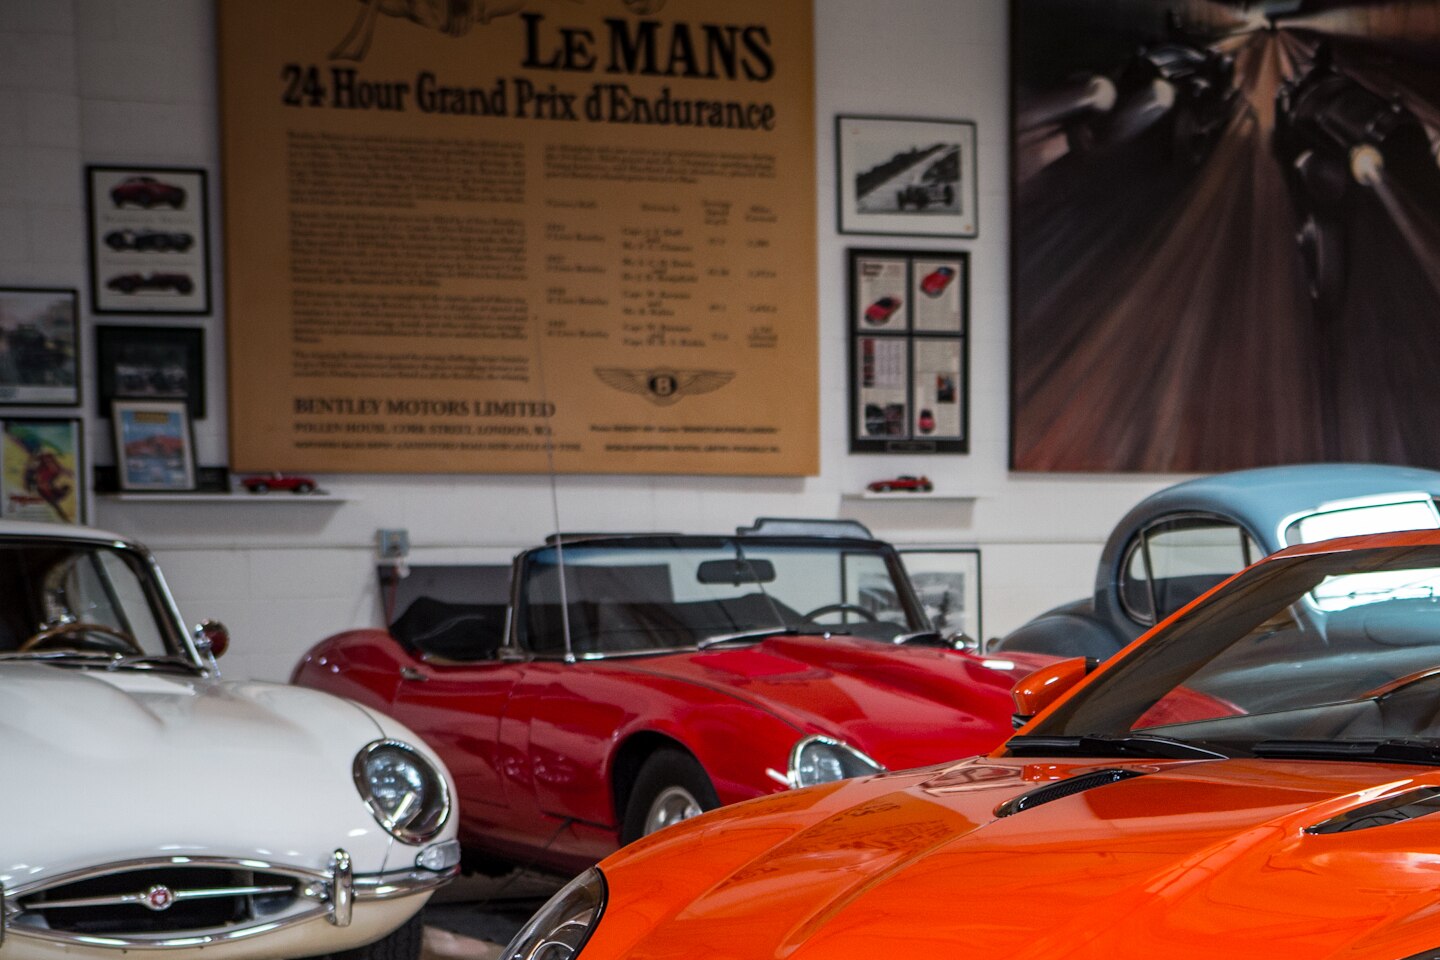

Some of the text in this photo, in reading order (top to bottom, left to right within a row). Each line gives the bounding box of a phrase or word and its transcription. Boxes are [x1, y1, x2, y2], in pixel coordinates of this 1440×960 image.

[604, 18, 776, 83] MANS
[281, 63, 776, 131] 24 Hour Grand Prix d'Endurance
[294, 396, 557, 418] BENTLEY MOTORS LIMITED
